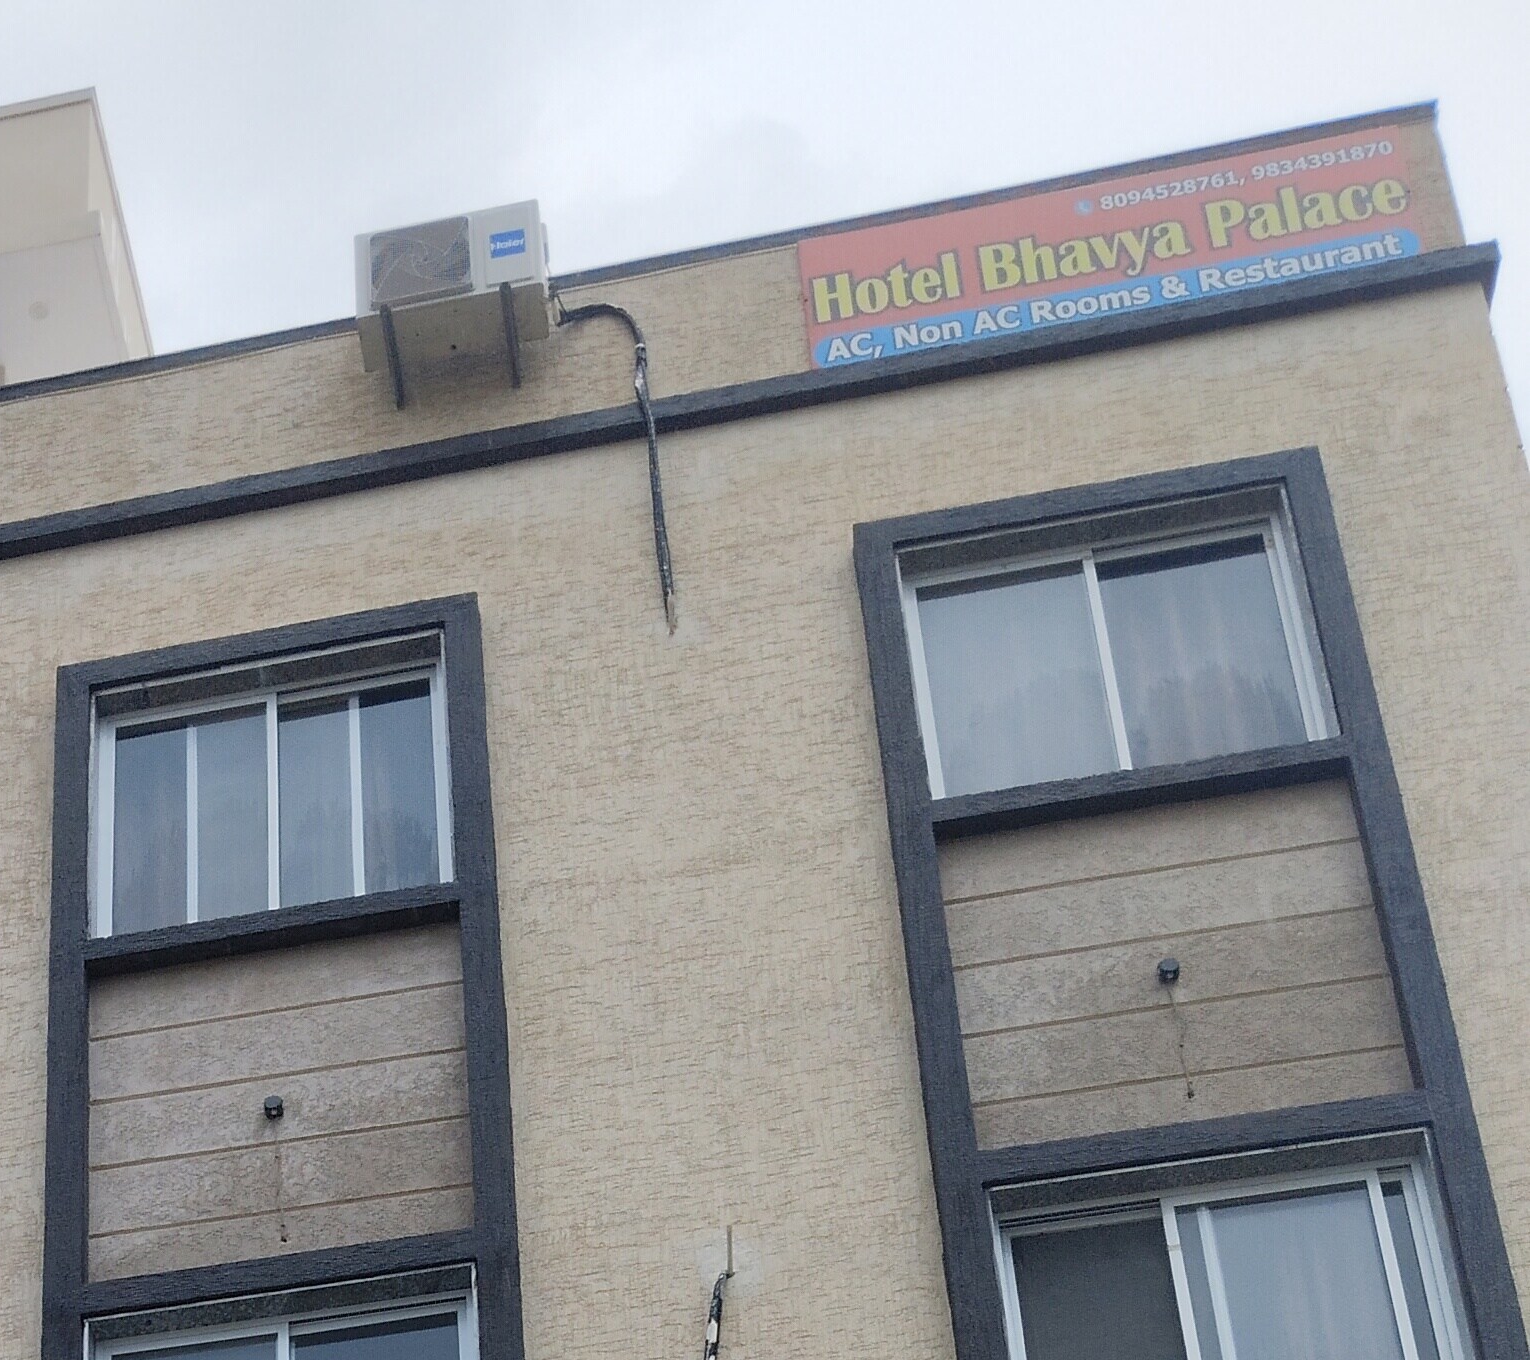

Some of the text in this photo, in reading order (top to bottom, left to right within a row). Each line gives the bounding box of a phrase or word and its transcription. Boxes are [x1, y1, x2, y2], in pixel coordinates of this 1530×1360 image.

[1099, 140, 1394, 211] 8094528761, 9834391870
[811, 178, 1408, 324] Hotel Bhavya Palace
[826, 233, 1404, 362] AC, Non AC Rooms & Restaurant
